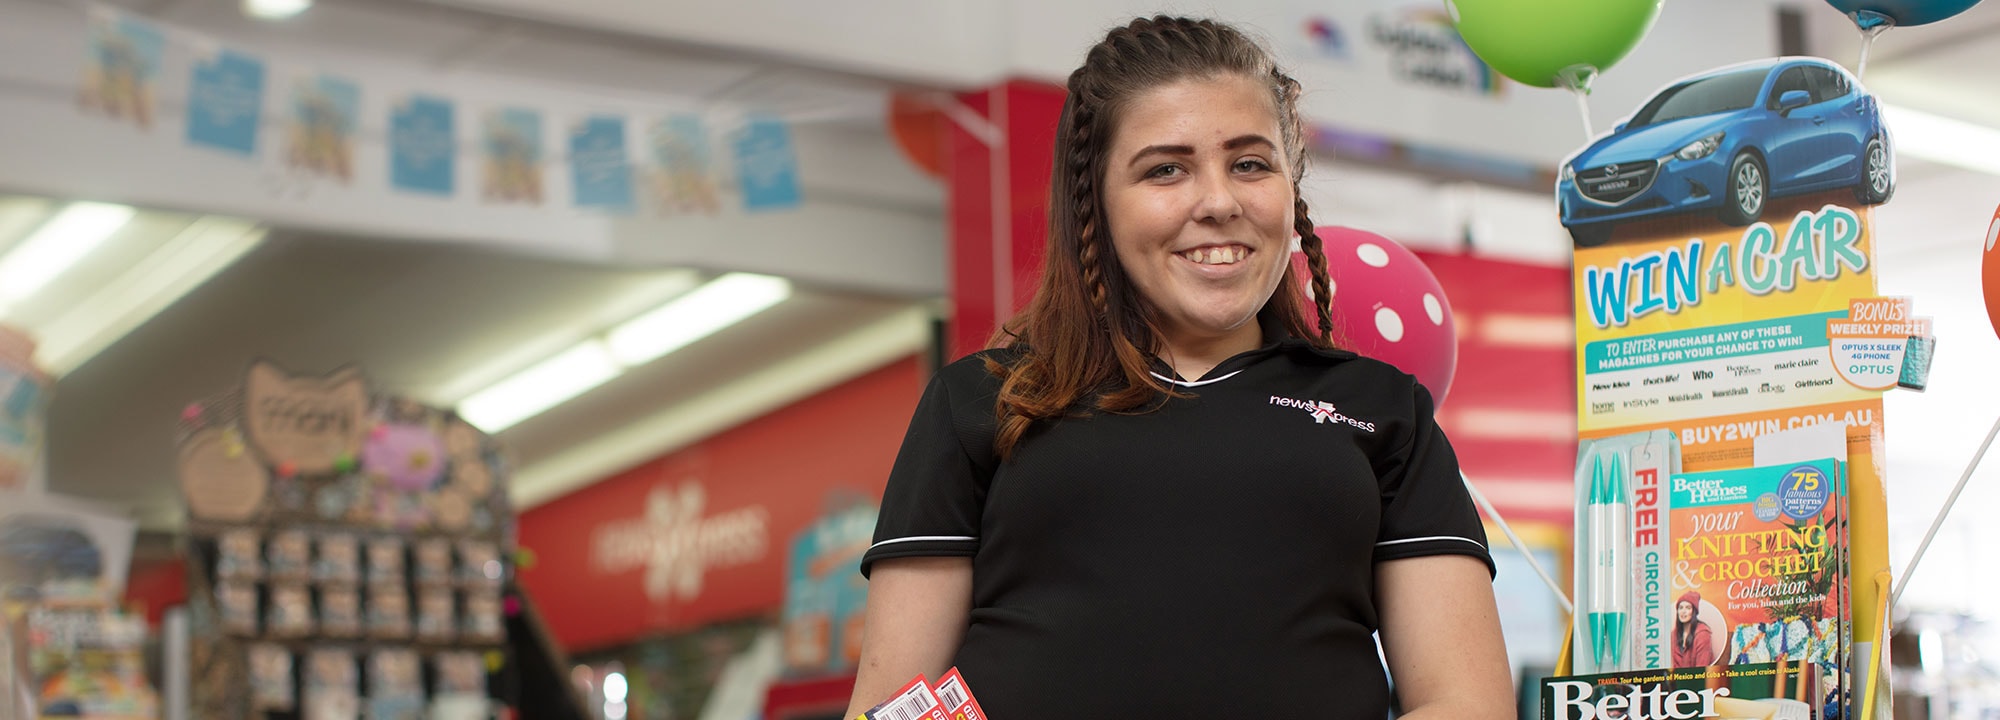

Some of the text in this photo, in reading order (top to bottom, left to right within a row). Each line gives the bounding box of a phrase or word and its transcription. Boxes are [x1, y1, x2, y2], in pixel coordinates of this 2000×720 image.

[1586, 207, 1868, 327] WIN A CAR
[1853, 302, 1904, 322] BONUS
[1830, 323, 1925, 334] WEEKLY PRIZE!
[1606, 325, 1792, 357] TO ENTER PURCHASE ANY OF THESE
[1599, 336, 1803, 370] MAGAZINES FOR YOUR CHANCE TO WIN!
[1774, 358, 1819, 370] marie claire
[1849, 365, 1895, 374] OPTUS
[1692, 371, 1714, 380] Who
[1794, 378, 1833, 388] Girlfriend
[1673, 478, 1724, 493] Better
[1791, 472, 1819, 491] 75
[1690, 485, 1747, 504] Homes
[1784, 488, 1823, 500] fabulous
[1785, 498, 1822, 507] patterns
[1635, 468, 1659, 548] FREE
[1684, 510, 1743, 543] your
[1675, 524, 1827, 561] KNITTING
[1672, 551, 1826, 590] & CROCHET
[1645, 551, 1660, 640] CIRCULAR
[1727, 576, 1808, 600] Collection
[1727, 594, 1827, 610] For you, him and the kids
[1643, 674, 1665, 684] gardens
[1674, 672, 1693, 680] Mexico
[1694, 671, 1705, 679] and
[1706, 671, 1720, 679] Cuba
[1725, 669, 1739, 677] Take
[1546, 680, 1731, 720] Better
